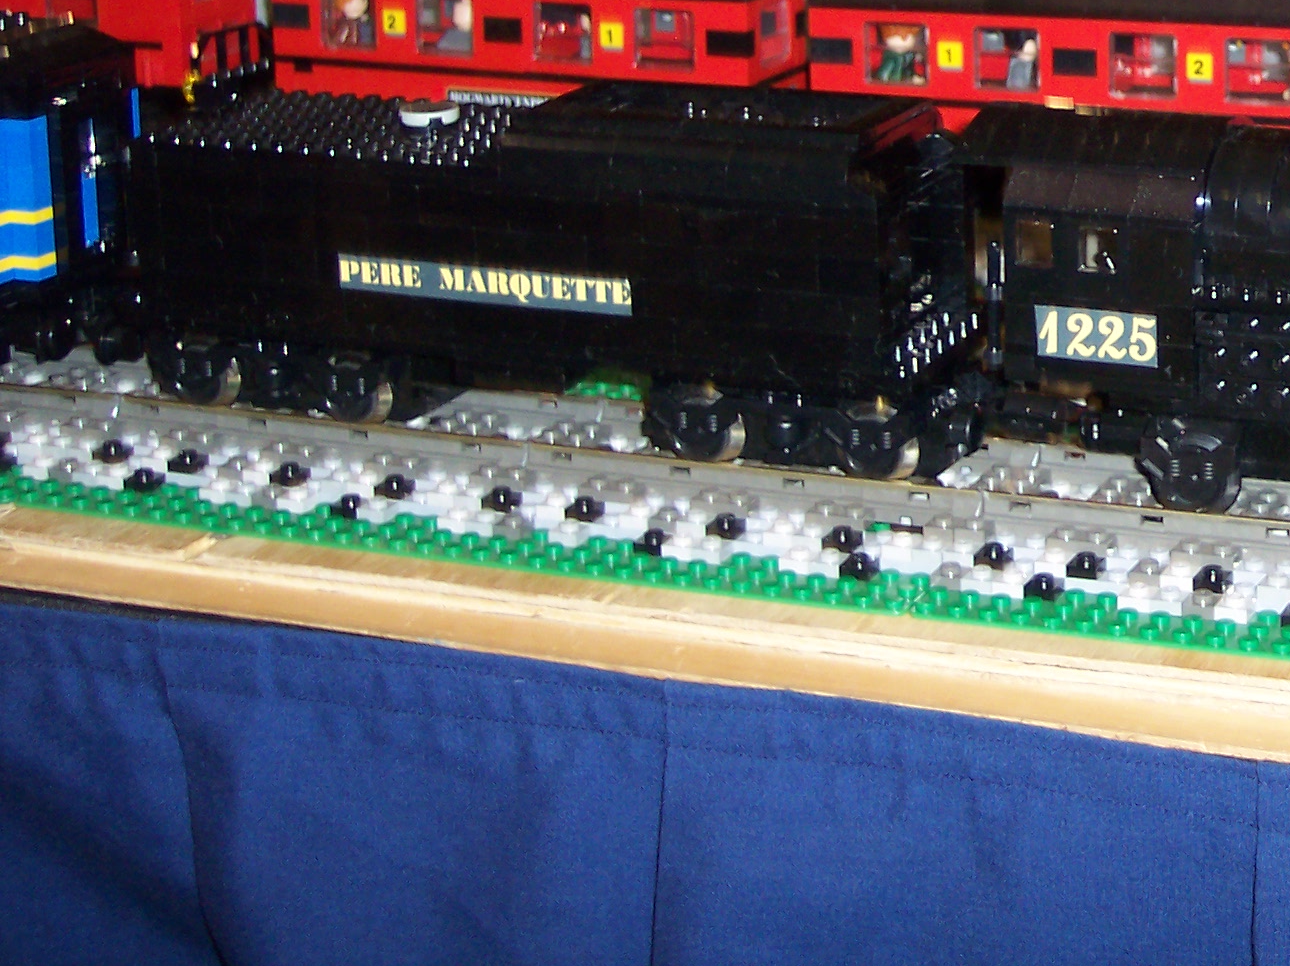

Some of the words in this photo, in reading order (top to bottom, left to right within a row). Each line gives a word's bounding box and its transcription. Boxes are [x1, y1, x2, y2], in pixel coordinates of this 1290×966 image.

[386, 13, 396, 30] 2
[606, 29, 614, 44] 1
[945, 47, 953, 64] 1
[1193, 59, 1204, 76] 2
[339, 260, 422, 289] PERE
[439, 266, 632, 306] MARQUETTE
[1038, 310, 1157, 362] 1225
